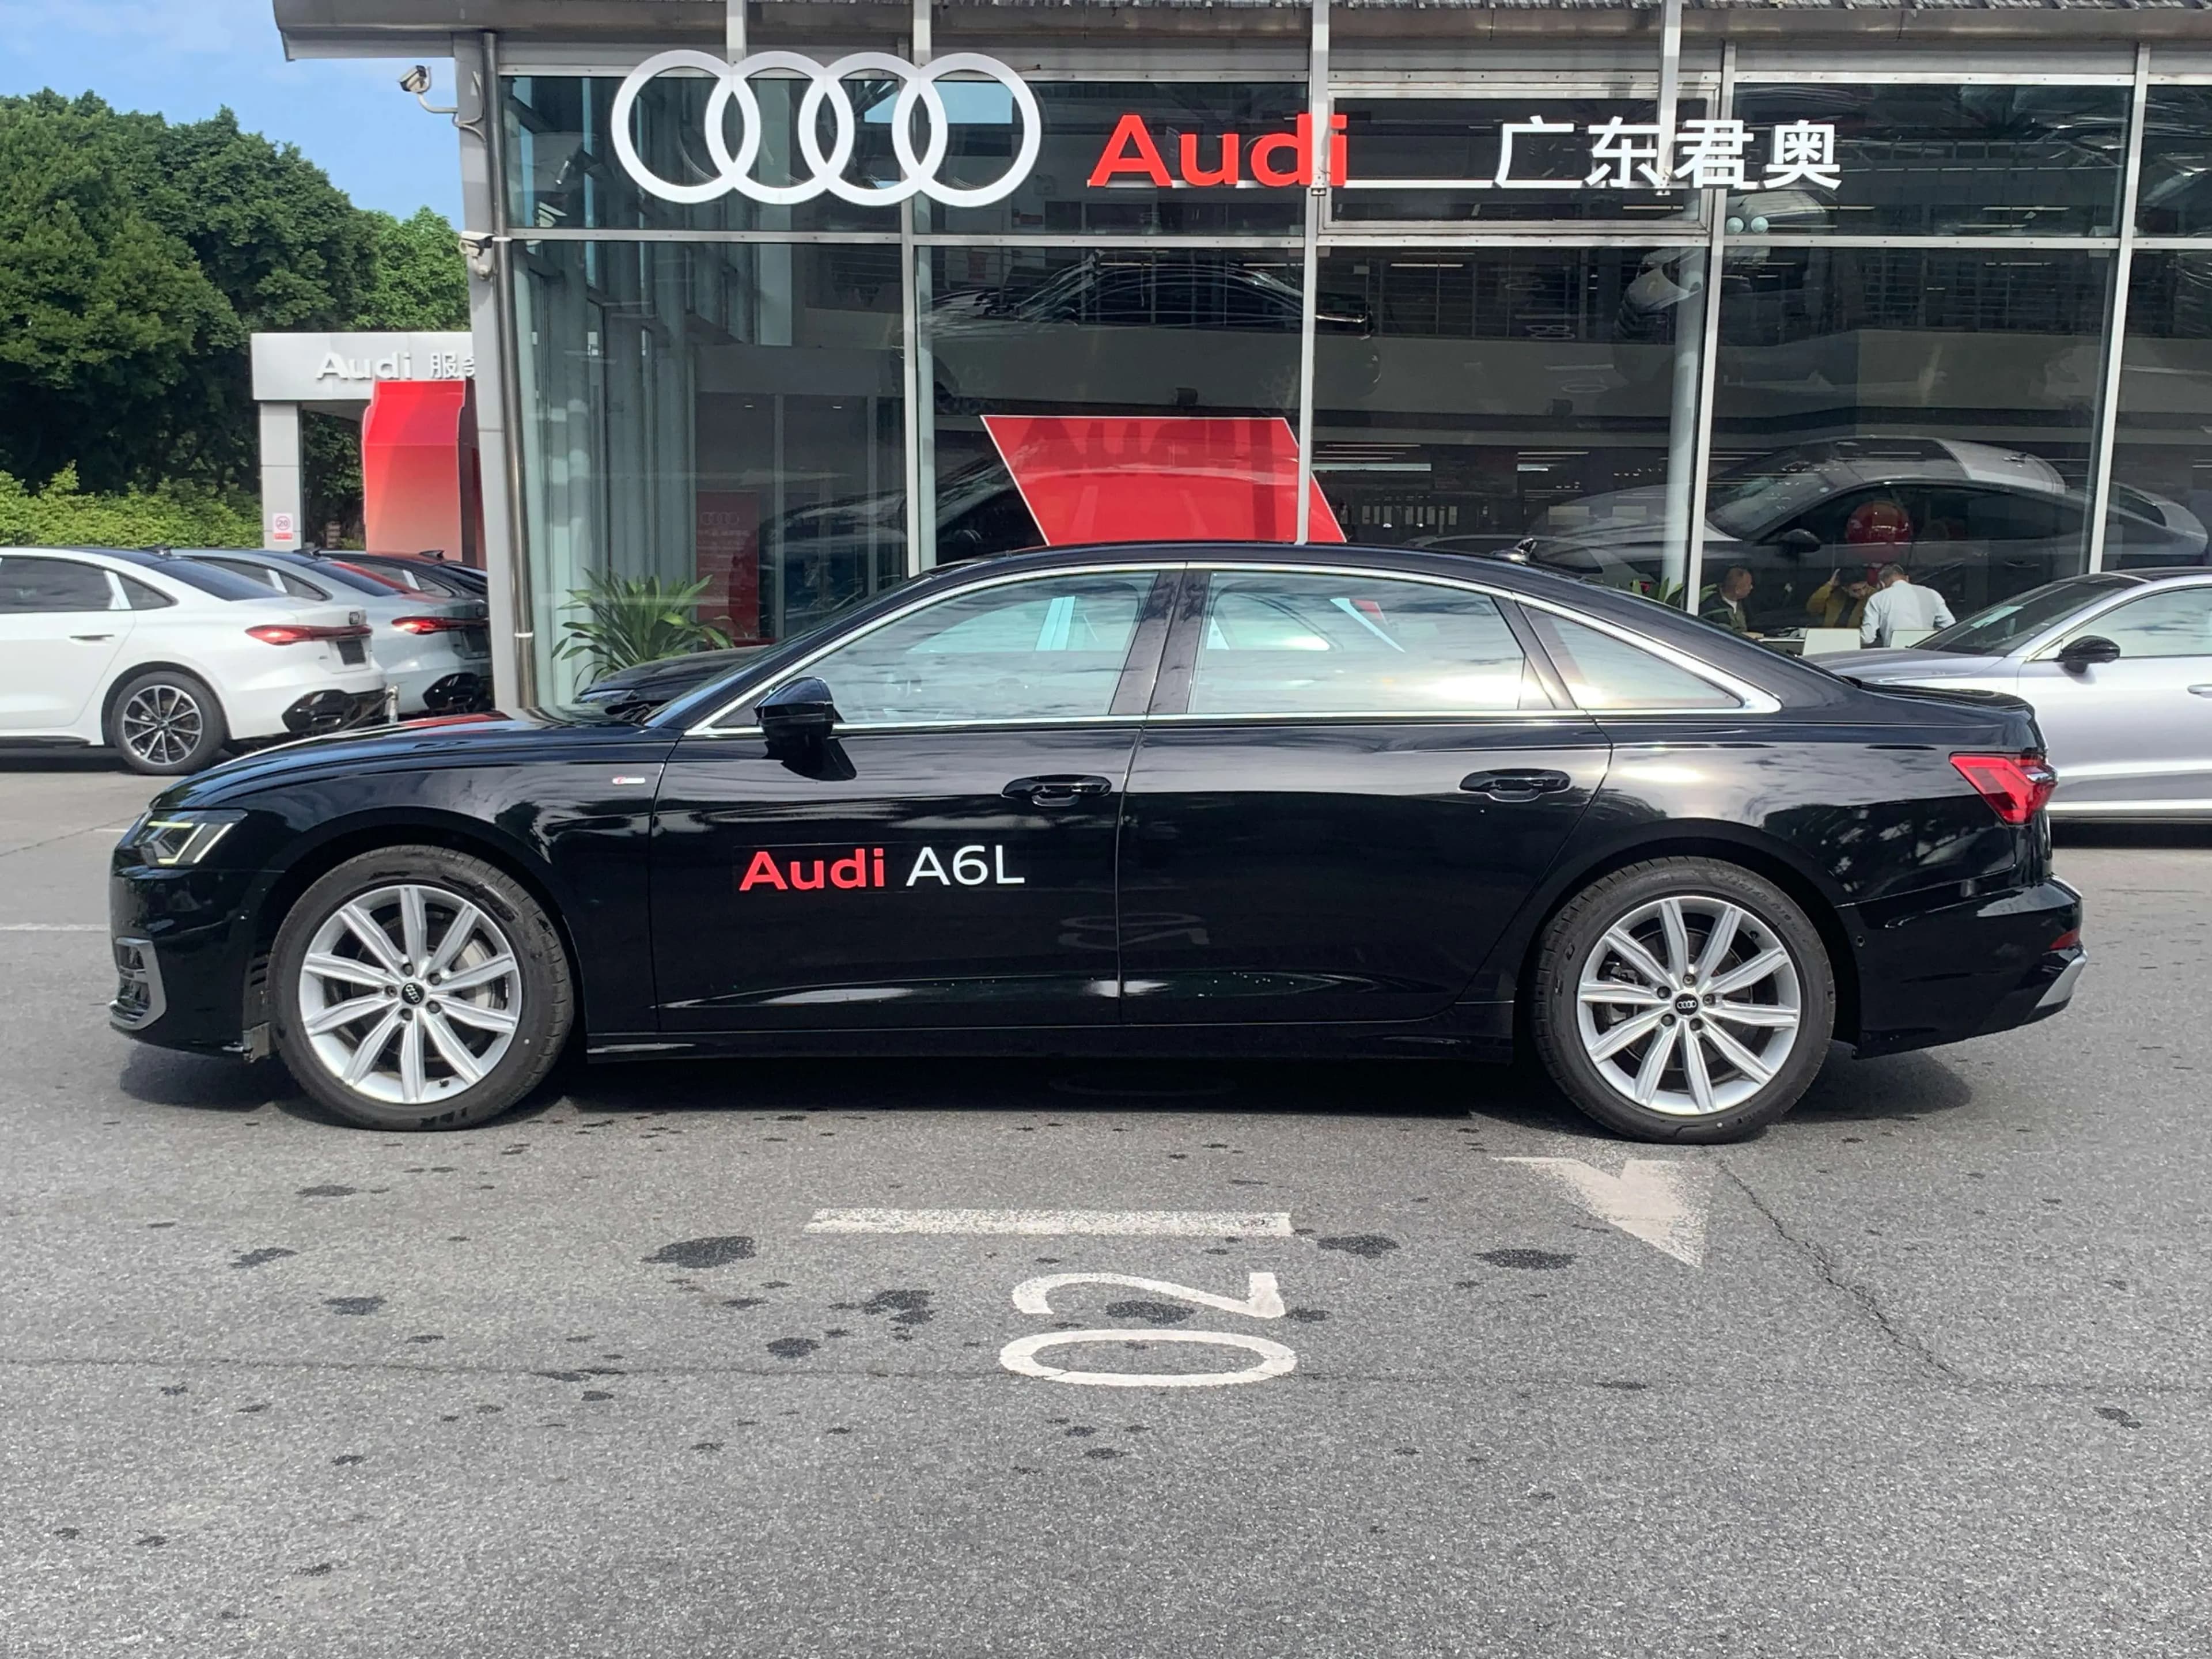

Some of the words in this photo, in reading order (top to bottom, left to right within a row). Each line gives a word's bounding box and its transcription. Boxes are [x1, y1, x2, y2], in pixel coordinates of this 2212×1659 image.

[1088, 113, 1347, 187] Audi
[1494, 115, 1842, 191] 广东君奥
[316, 351, 412, 380] Audi
[739, 848, 885, 891] Audi
[906, 844, 1025, 887] A6L
